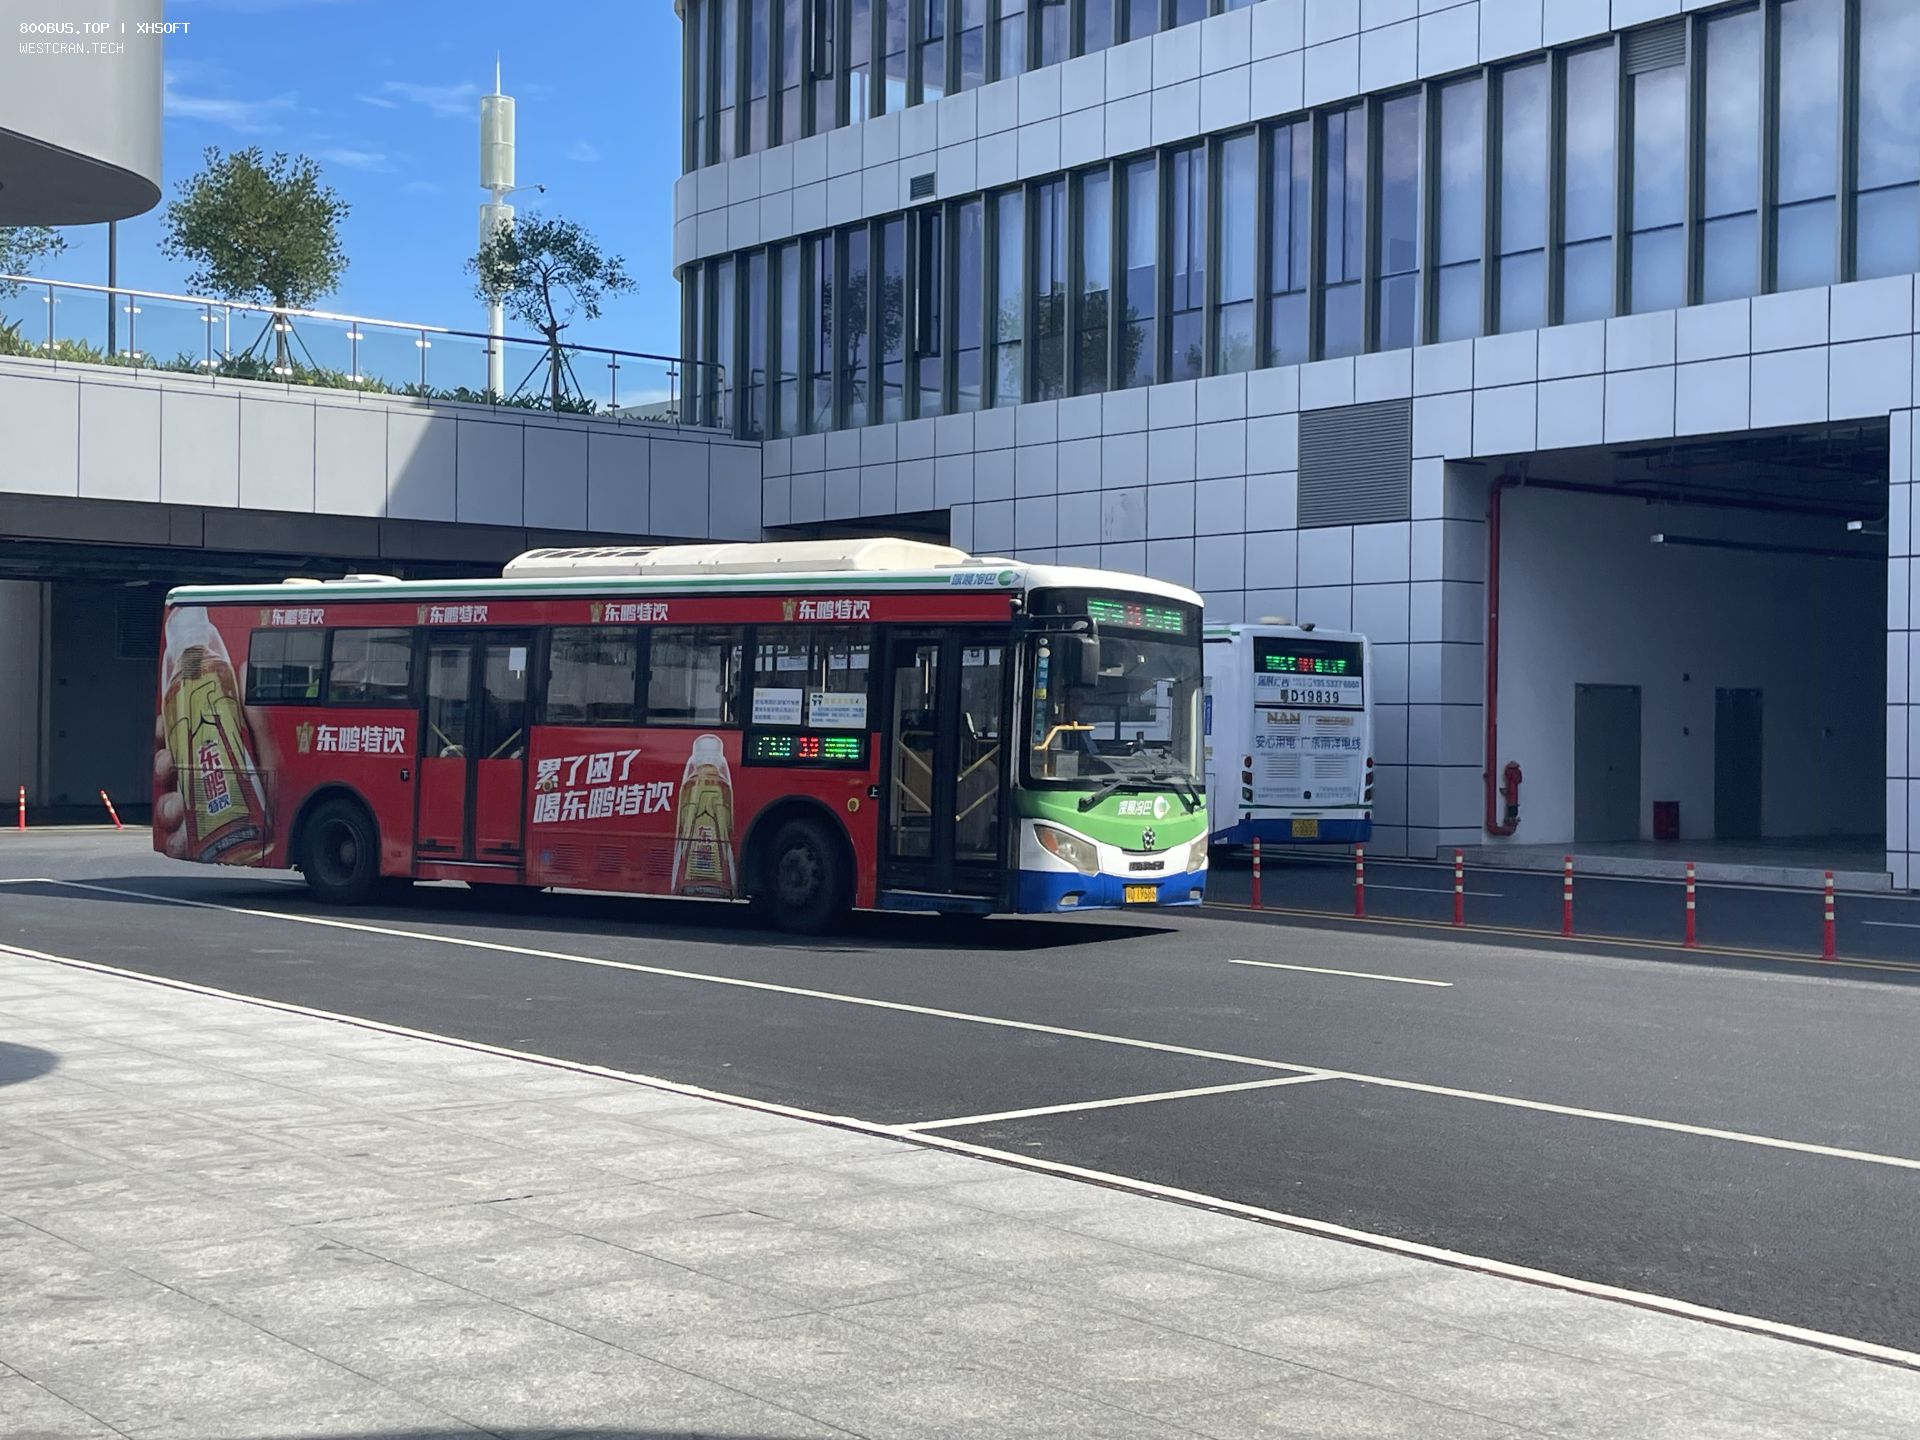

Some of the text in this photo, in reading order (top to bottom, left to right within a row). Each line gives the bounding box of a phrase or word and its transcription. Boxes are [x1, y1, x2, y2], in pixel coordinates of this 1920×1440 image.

[271, 608, 325, 625] 东鹏特饮
[430, 605, 488, 623] 东鹏特饮
[604, 603, 668, 621] 东鹏特饮
[799, 599, 871, 620] 东鹏特饮
[316, 724, 405, 754] 东鹏特饮
[534, 749, 642, 791] 累了困了
[869, 786, 879, 798] 上
[532, 781, 675, 824] 喝东鹏特饮
